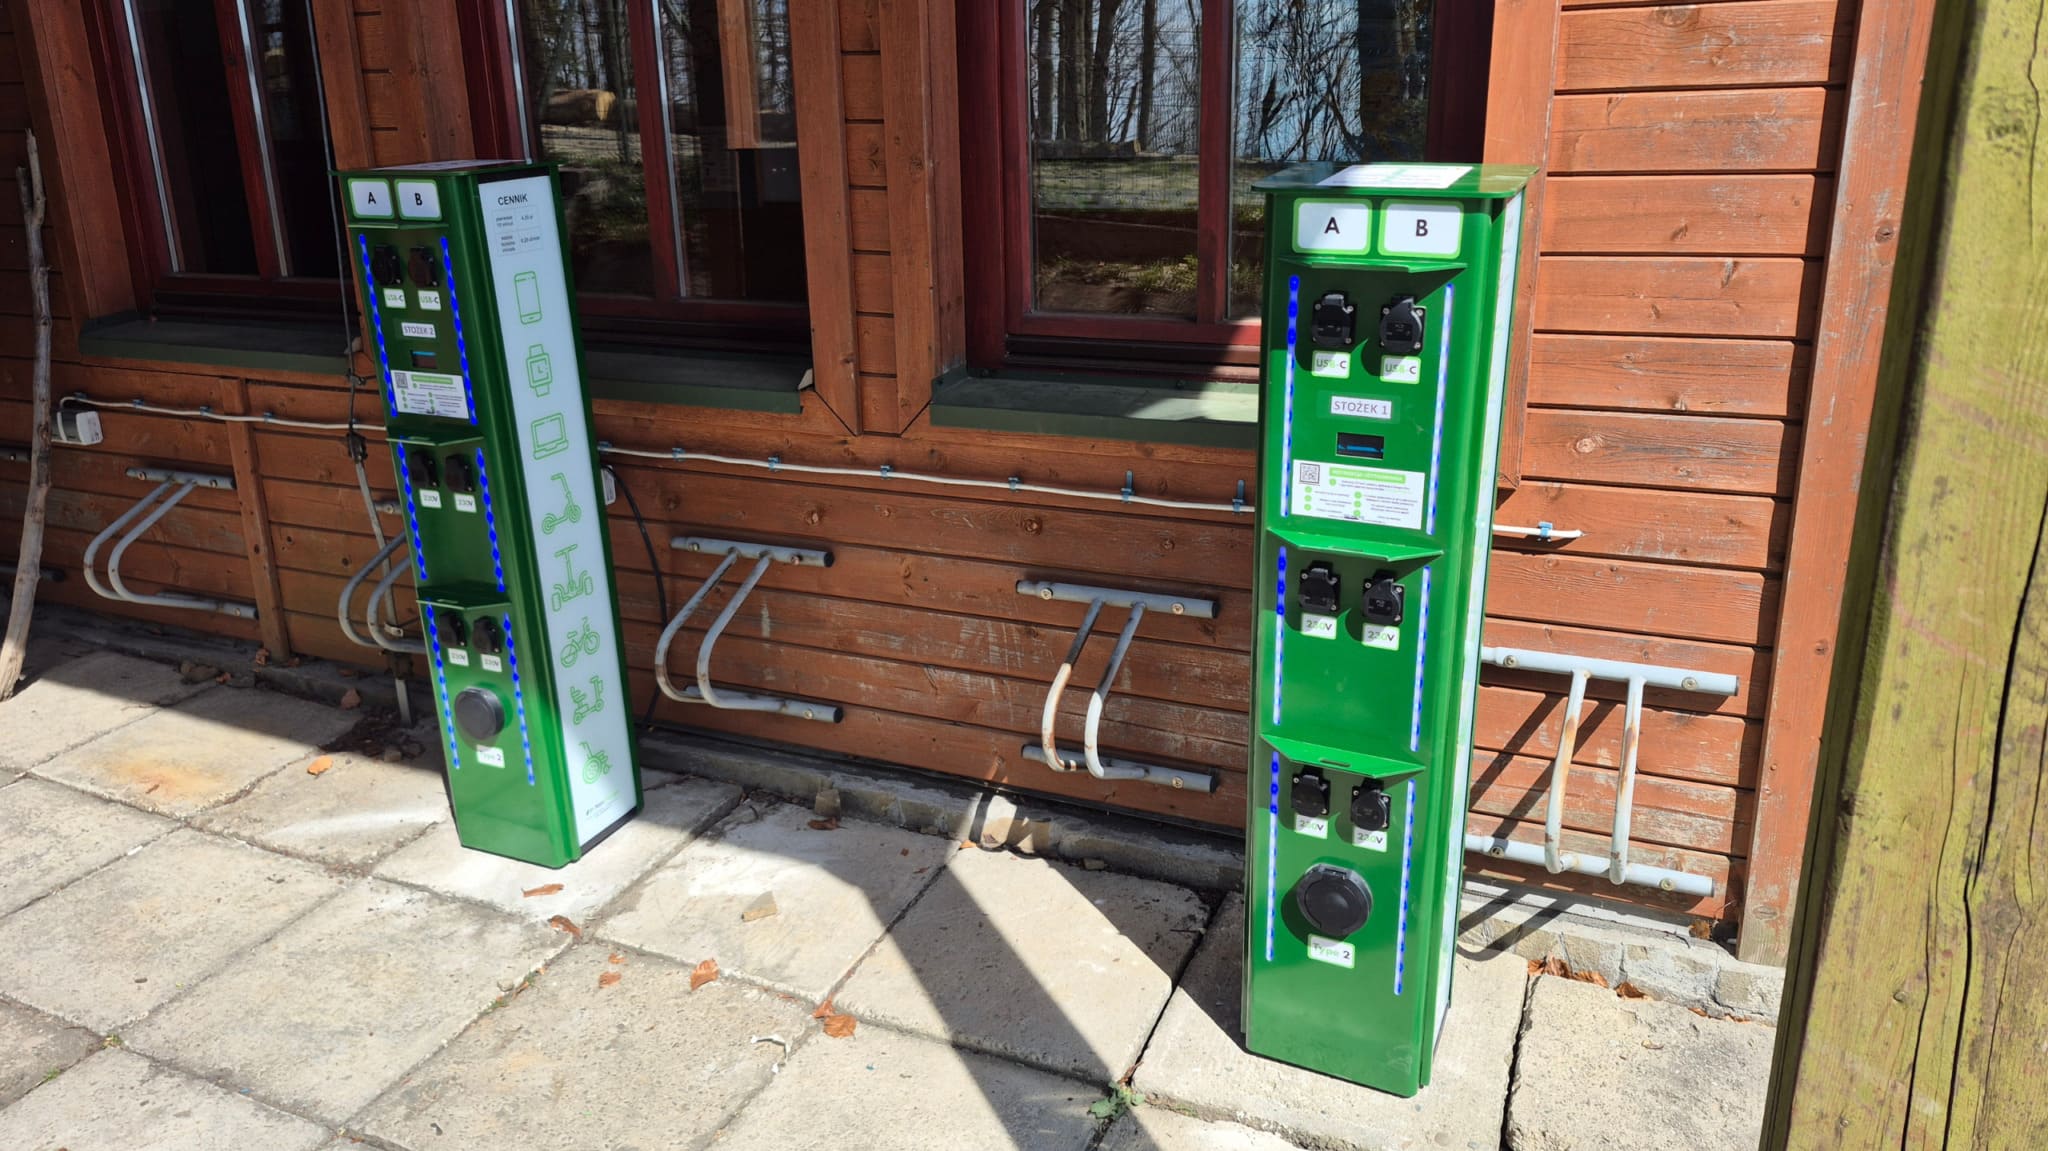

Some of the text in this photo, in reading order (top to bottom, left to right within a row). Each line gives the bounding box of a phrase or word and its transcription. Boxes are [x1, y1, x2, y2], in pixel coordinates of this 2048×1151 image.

[367, 191, 377, 205] A
[414, 192, 423, 206] B
[497, 193, 529, 206] CENNIK
[1324, 216, 1340, 235] A
[1415, 219, 1429, 237] B
[386, 294, 404, 303] USB-C
[420, 295, 439, 304] USB-C
[429, 327, 434, 336] 2
[1316, 358, 1347, 370] USB-C
[1385, 363, 1417, 375] USB-C
[1333, 399, 1388, 415] STOŻEK 1
[1306, 619, 1332, 631] 230V
[1368, 630, 1395, 642] 230V
[496, 753, 502, 761] 2
[1299, 819, 1324, 831] 230V
[1357, 832, 1383, 844] 230V
[1312, 942, 1350, 960] Type 2
